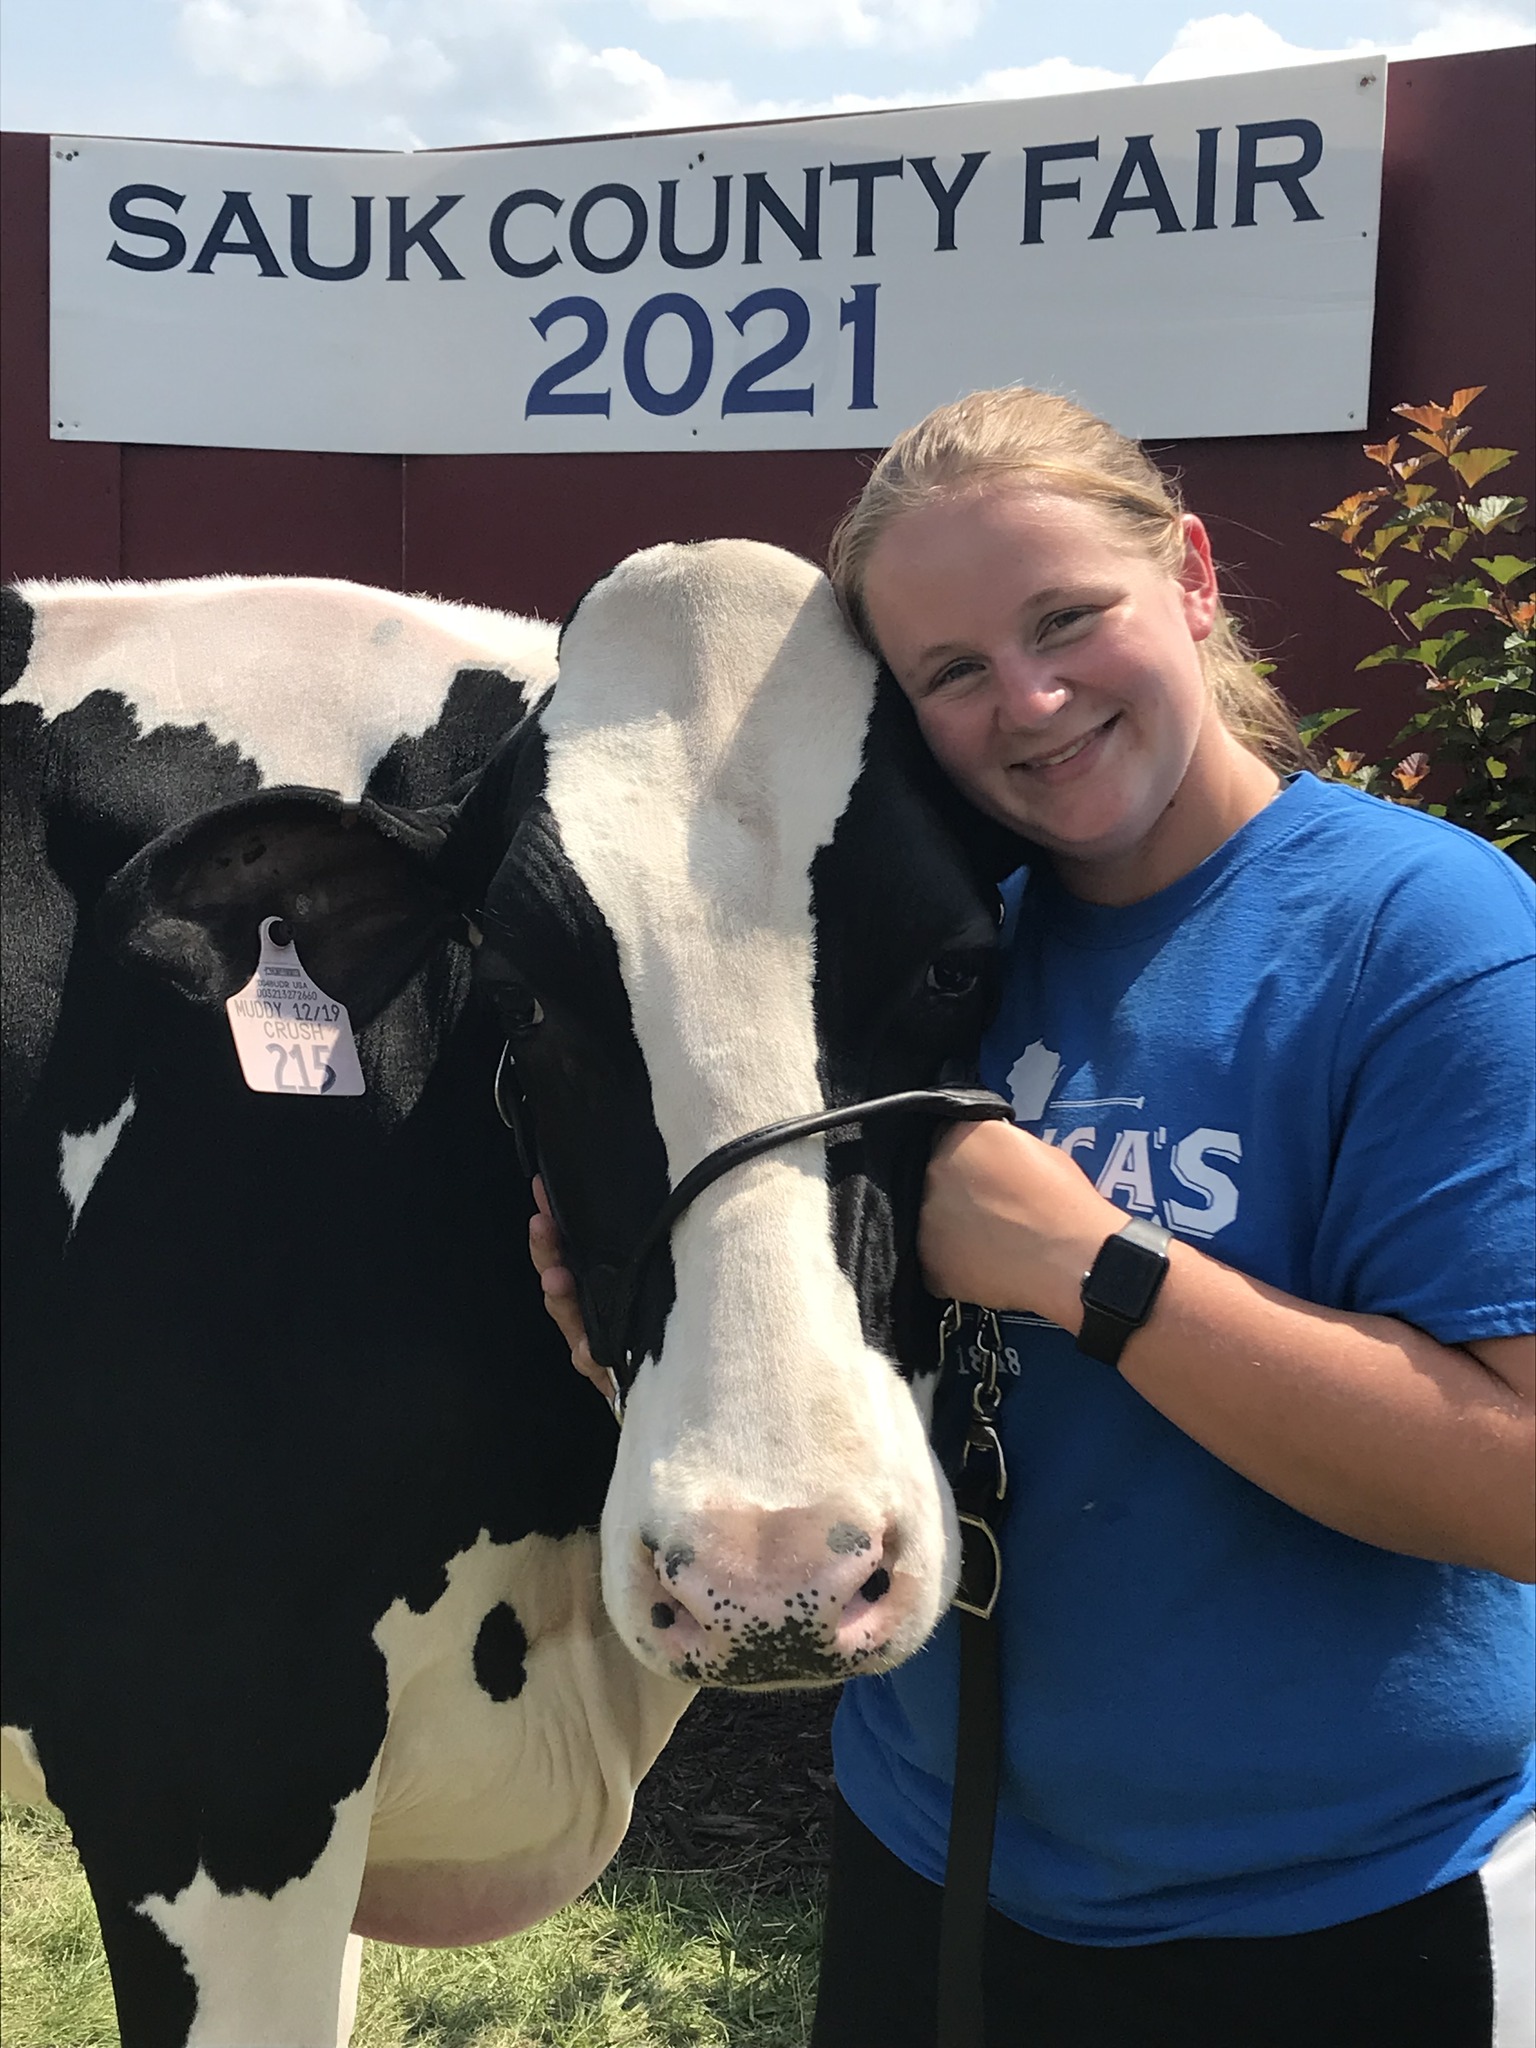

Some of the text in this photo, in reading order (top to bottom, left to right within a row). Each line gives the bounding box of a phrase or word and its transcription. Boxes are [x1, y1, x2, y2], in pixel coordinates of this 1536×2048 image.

[106, 118, 1325, 282] SAUK COUNTY FAIR
[525, 283, 881, 420] 2021
[292, 980, 308, 990] USA
[233, 999, 340, 1022] MUDDY 12/19
[263, 1021, 325, 1041] CRUSH
[265, 1043, 337, 1095] 215
